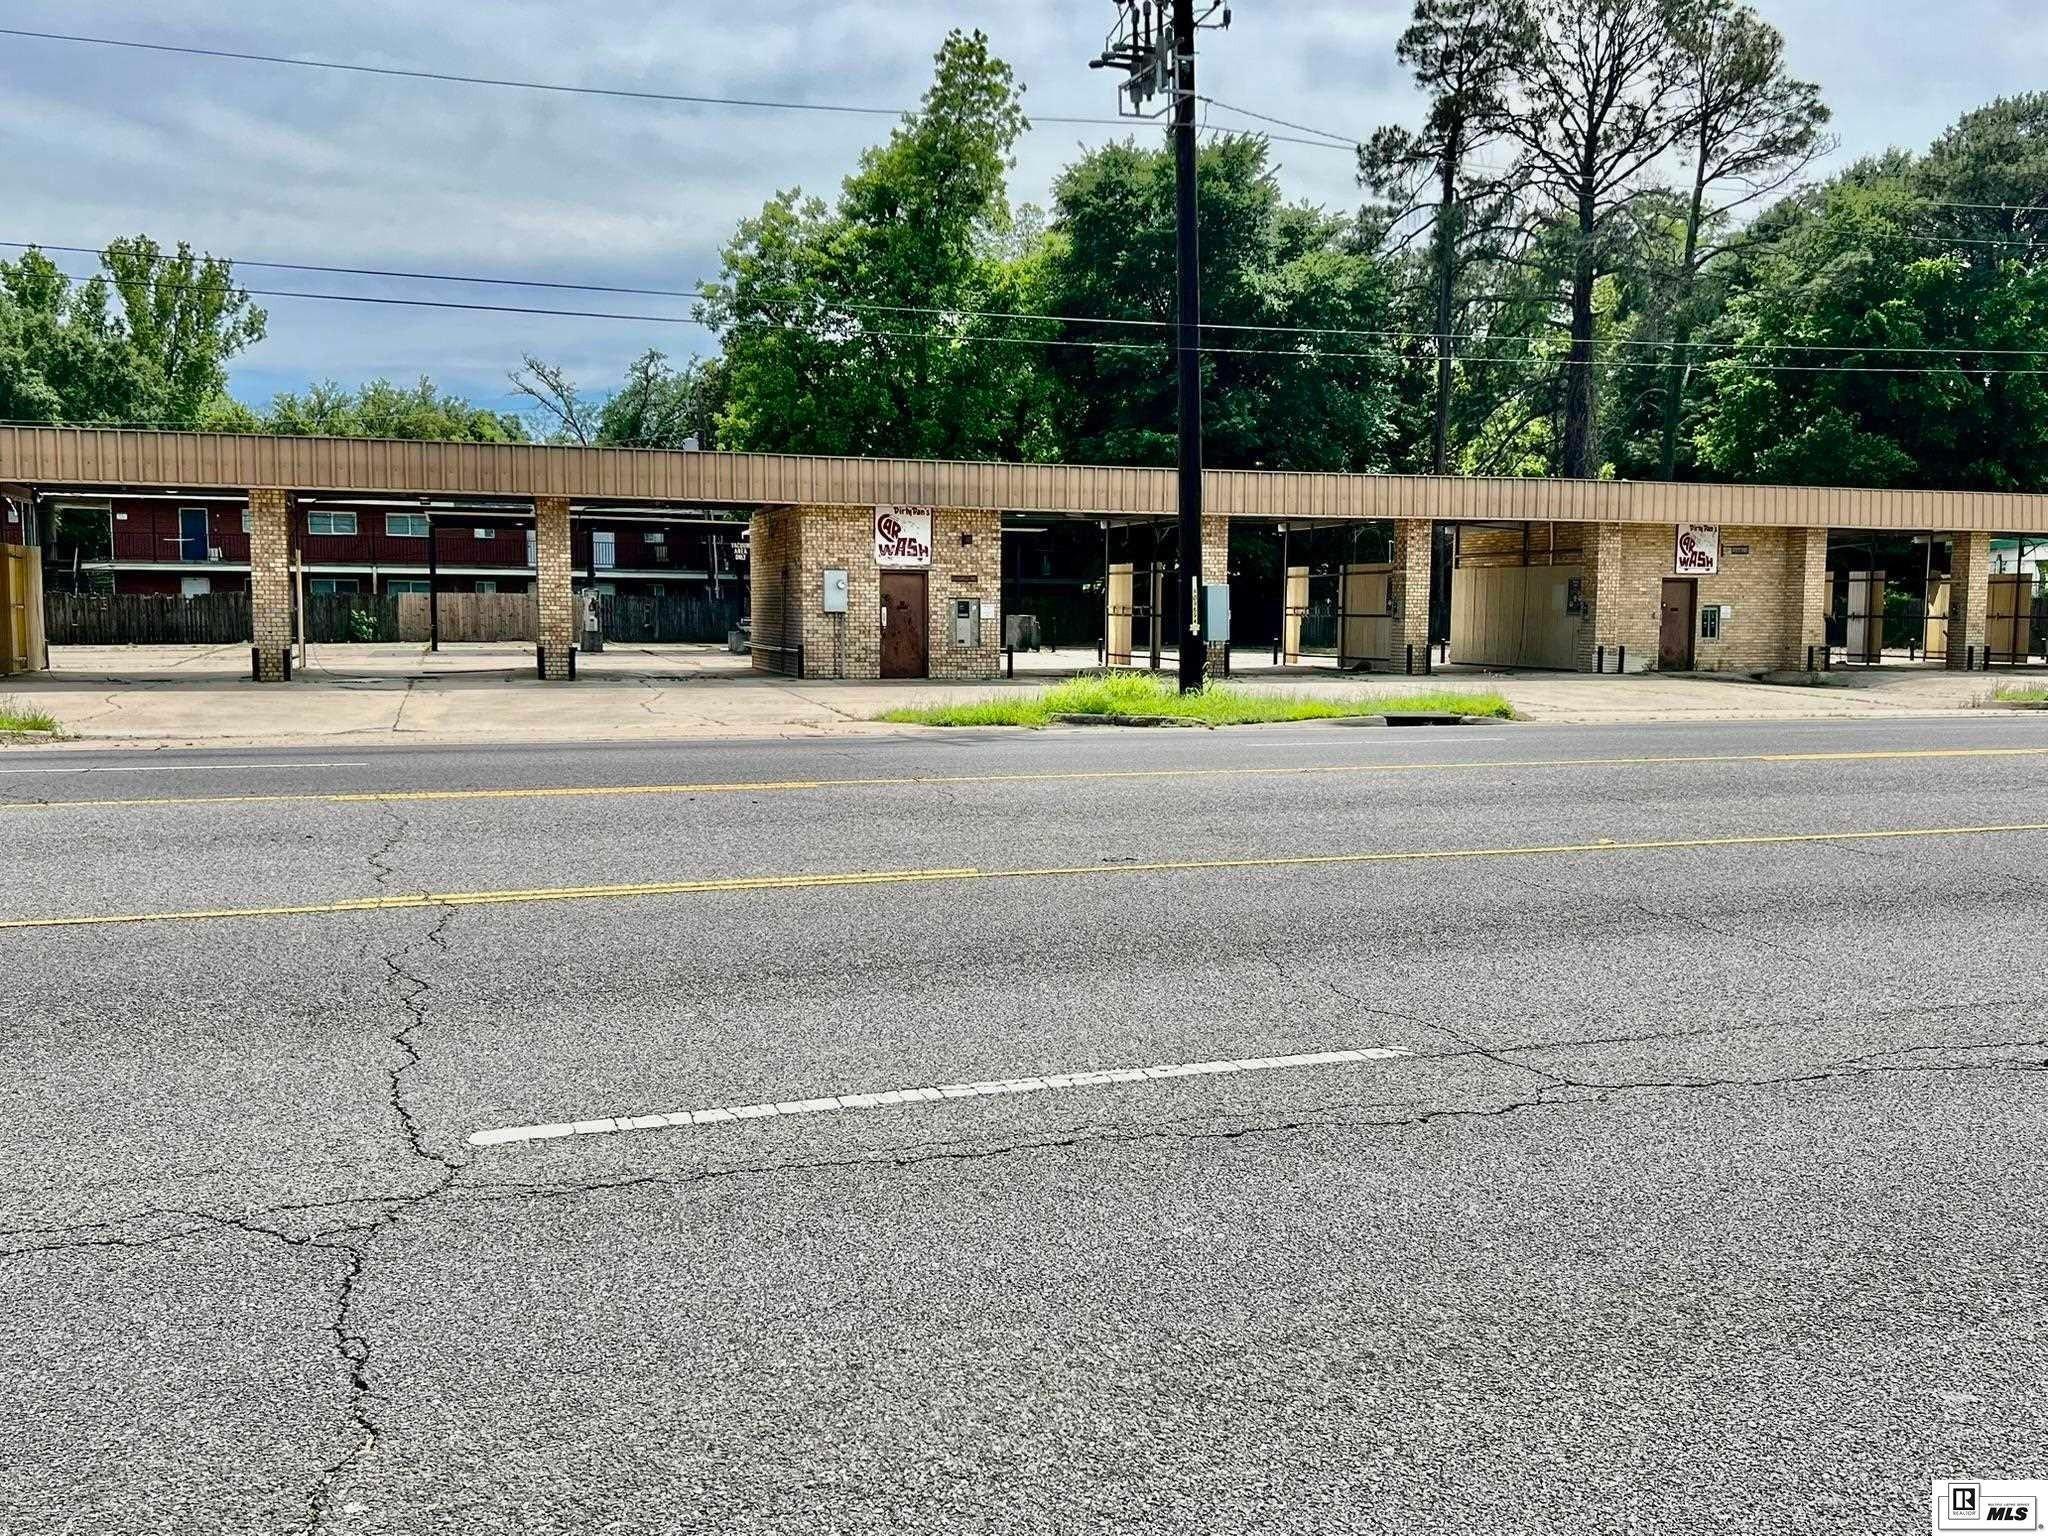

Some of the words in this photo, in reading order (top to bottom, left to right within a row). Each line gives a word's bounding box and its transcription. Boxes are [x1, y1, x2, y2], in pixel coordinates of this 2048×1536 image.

[893, 506, 912, 516] Dirty
[877, 513, 901, 543] CAR
[879, 537, 929, 557] WASH
[1679, 532, 1696, 556] CAR
[1679, 551, 1713, 567] WASH
